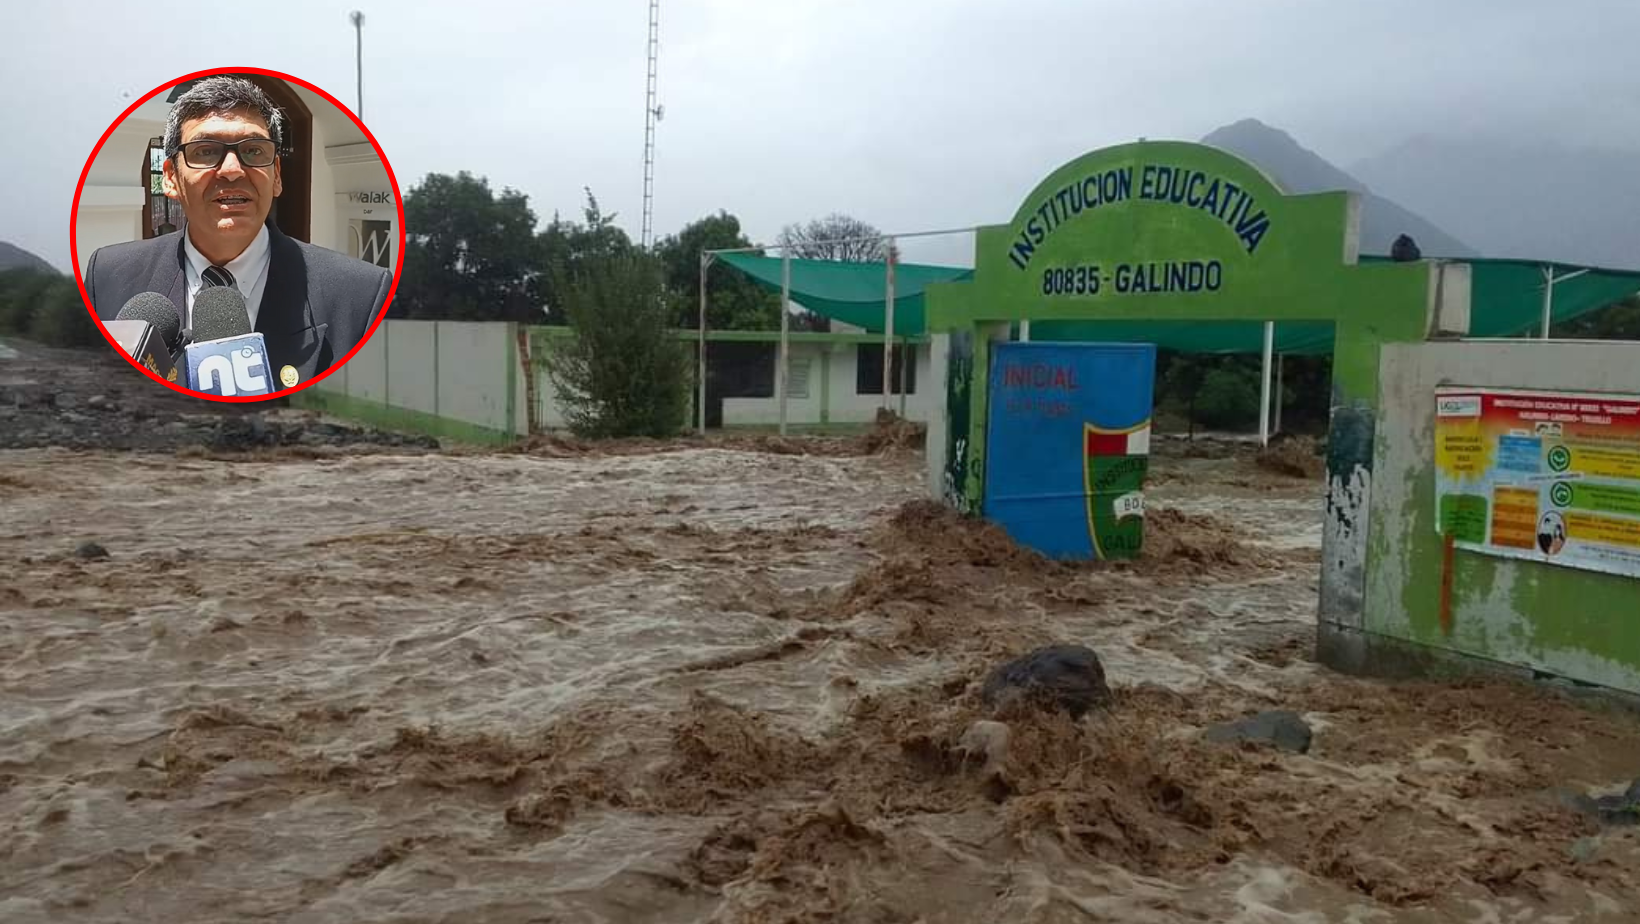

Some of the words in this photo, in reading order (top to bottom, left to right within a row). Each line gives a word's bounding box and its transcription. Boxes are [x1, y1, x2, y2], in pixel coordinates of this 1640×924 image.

[349, 191, 390, 204] Walak
[1008, 166, 1134, 270] INSTITUCION
[1140, 165, 1271, 256] EDUCATIVA
[1114, 260, 1223, 293] GALINDO
[1004, 363, 1081, 390] INICIAL
